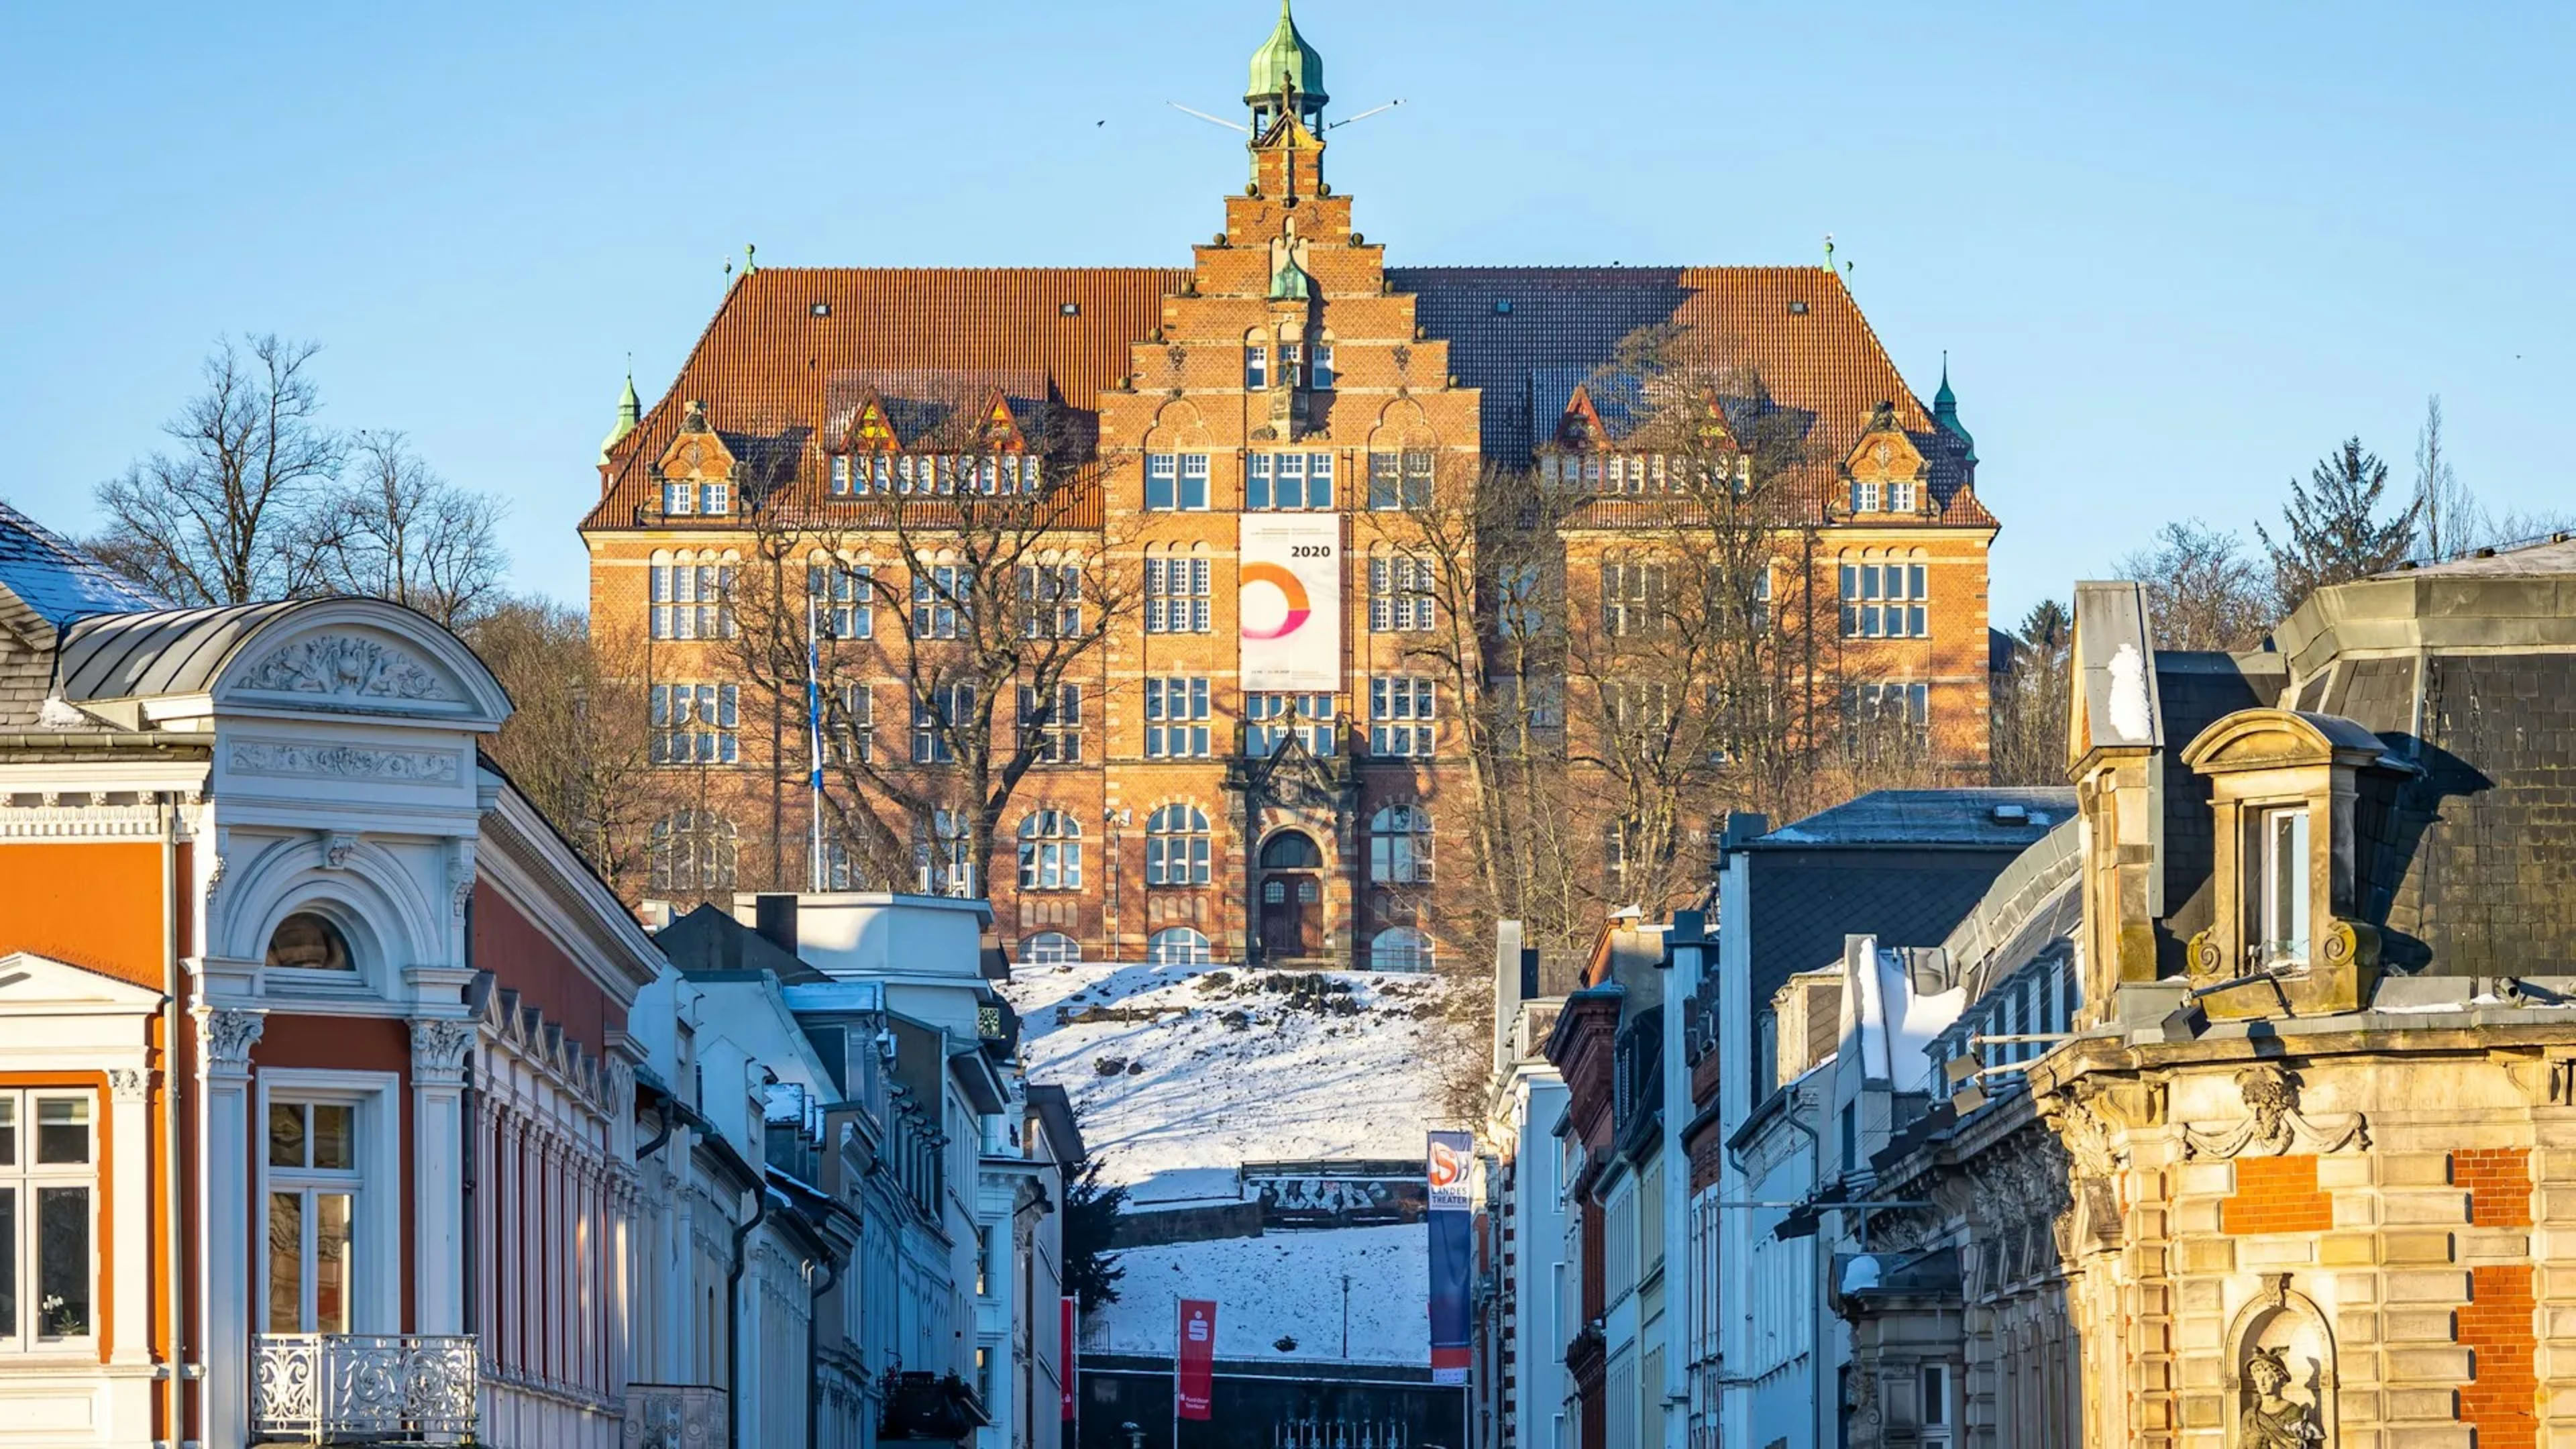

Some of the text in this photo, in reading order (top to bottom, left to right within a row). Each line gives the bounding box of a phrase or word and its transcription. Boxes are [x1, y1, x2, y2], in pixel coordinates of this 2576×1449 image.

[1291, 545, 1331, 558] 2020
[1432, 1187, 1467, 1195] LANDES
[1432, 1196, 1467, 1204] THEATER
